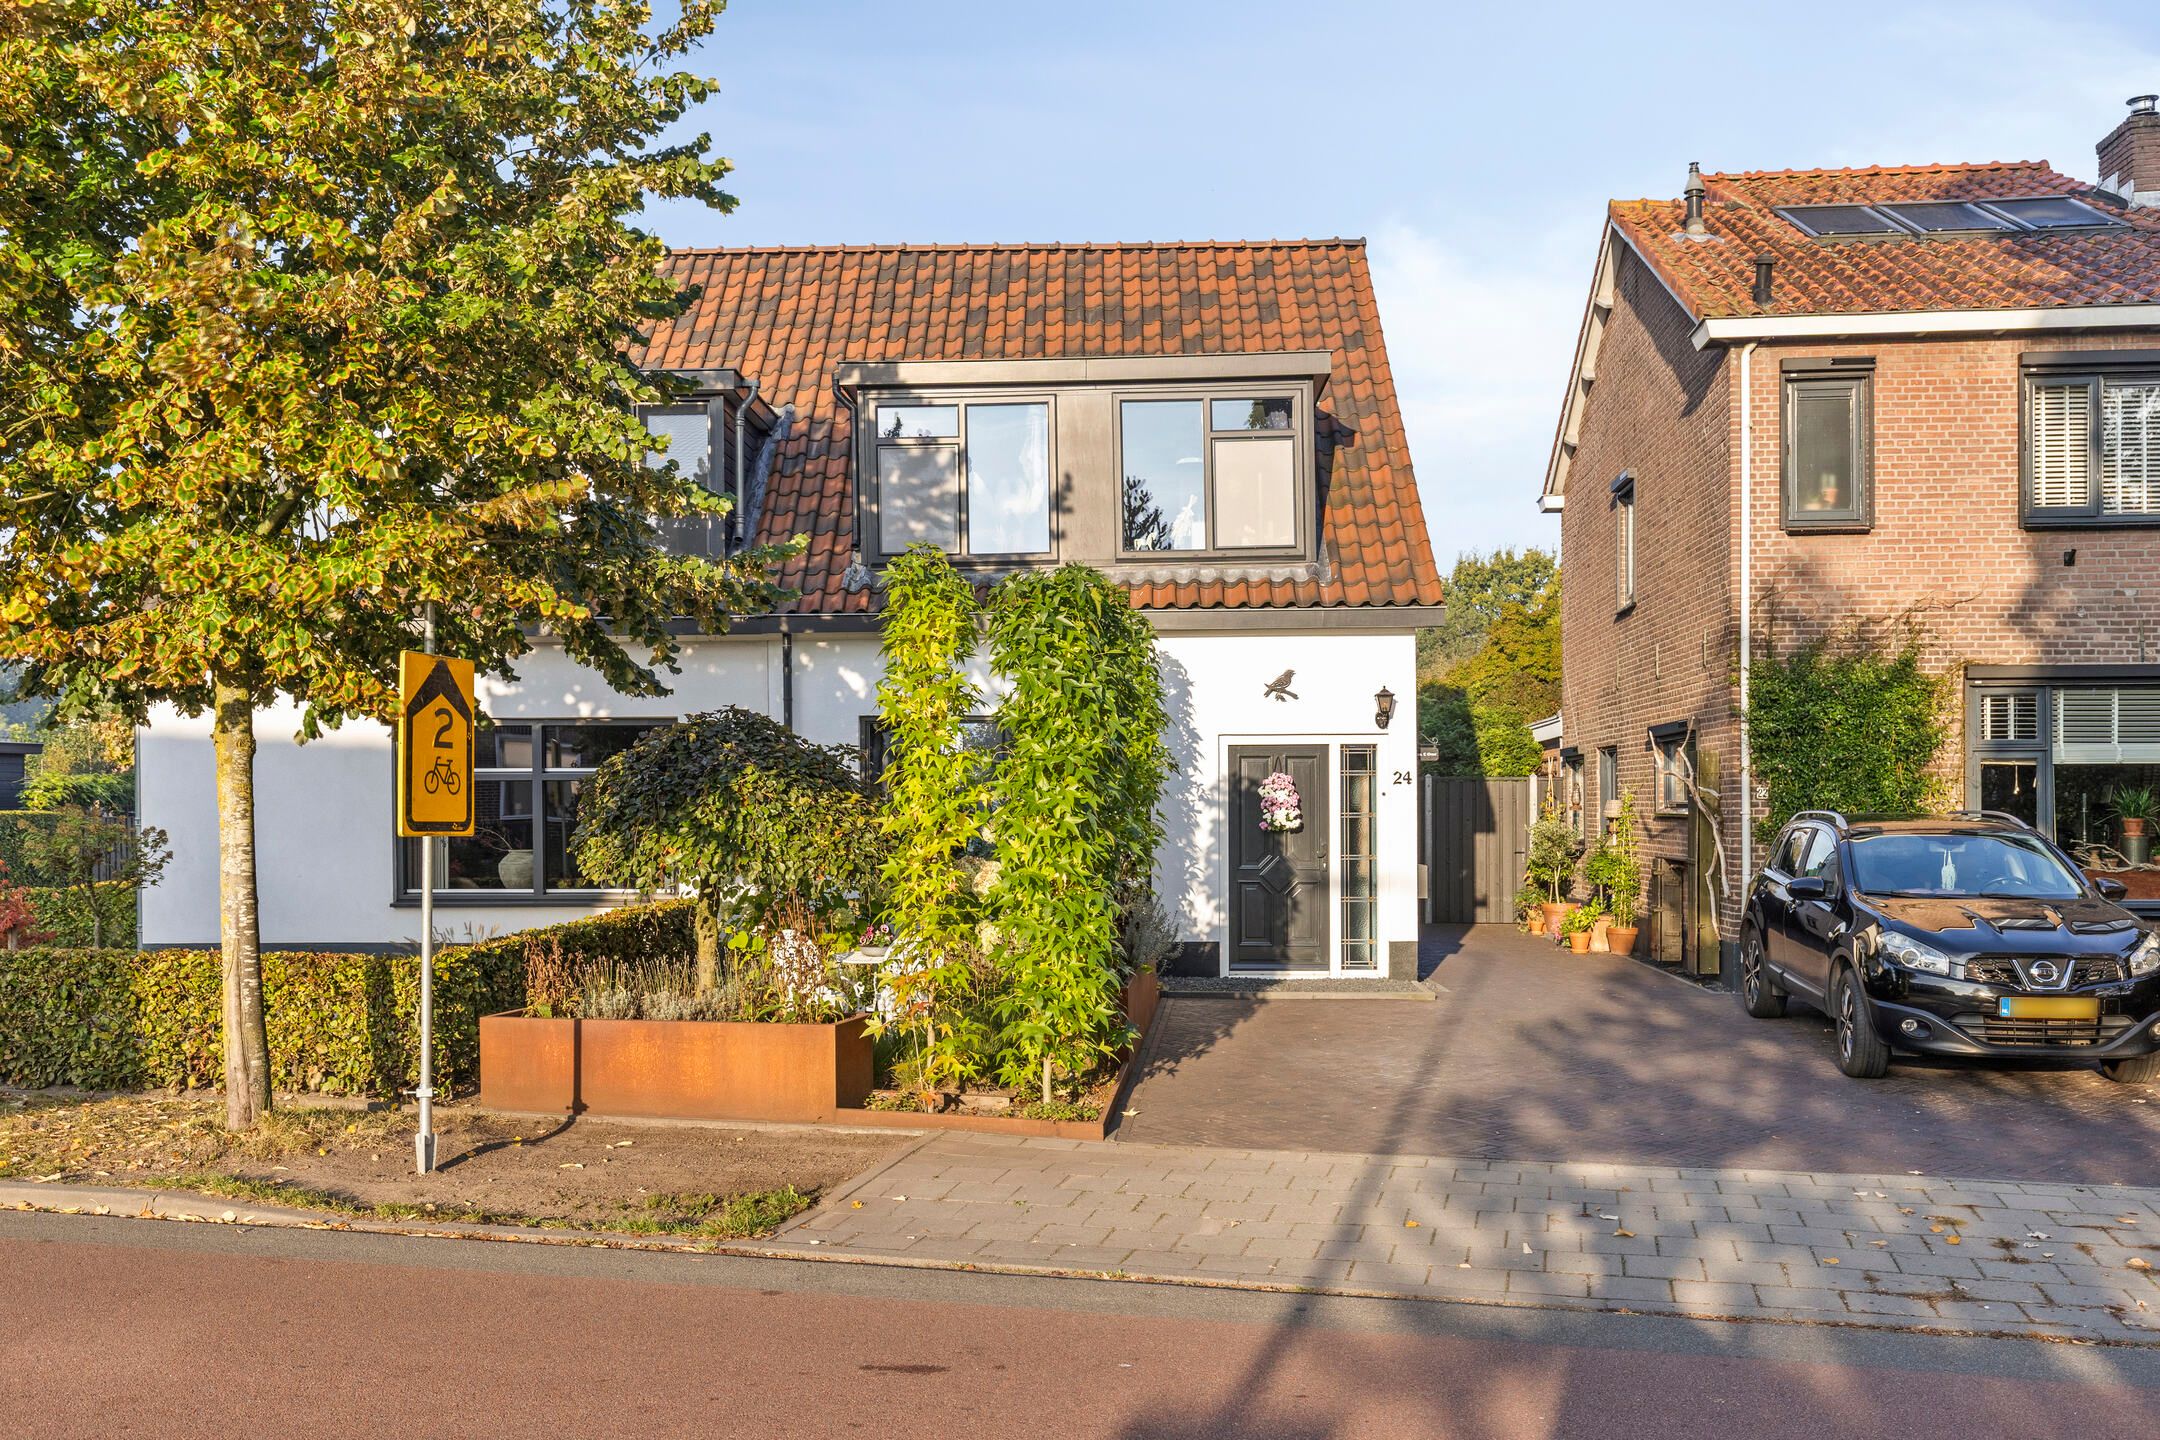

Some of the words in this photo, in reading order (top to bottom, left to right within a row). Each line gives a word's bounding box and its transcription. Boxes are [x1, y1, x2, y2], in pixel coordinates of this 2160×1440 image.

[434, 707, 454, 749] 2
[1393, 771, 1412, 785] 24
[1757, 788, 1768, 799] 22
